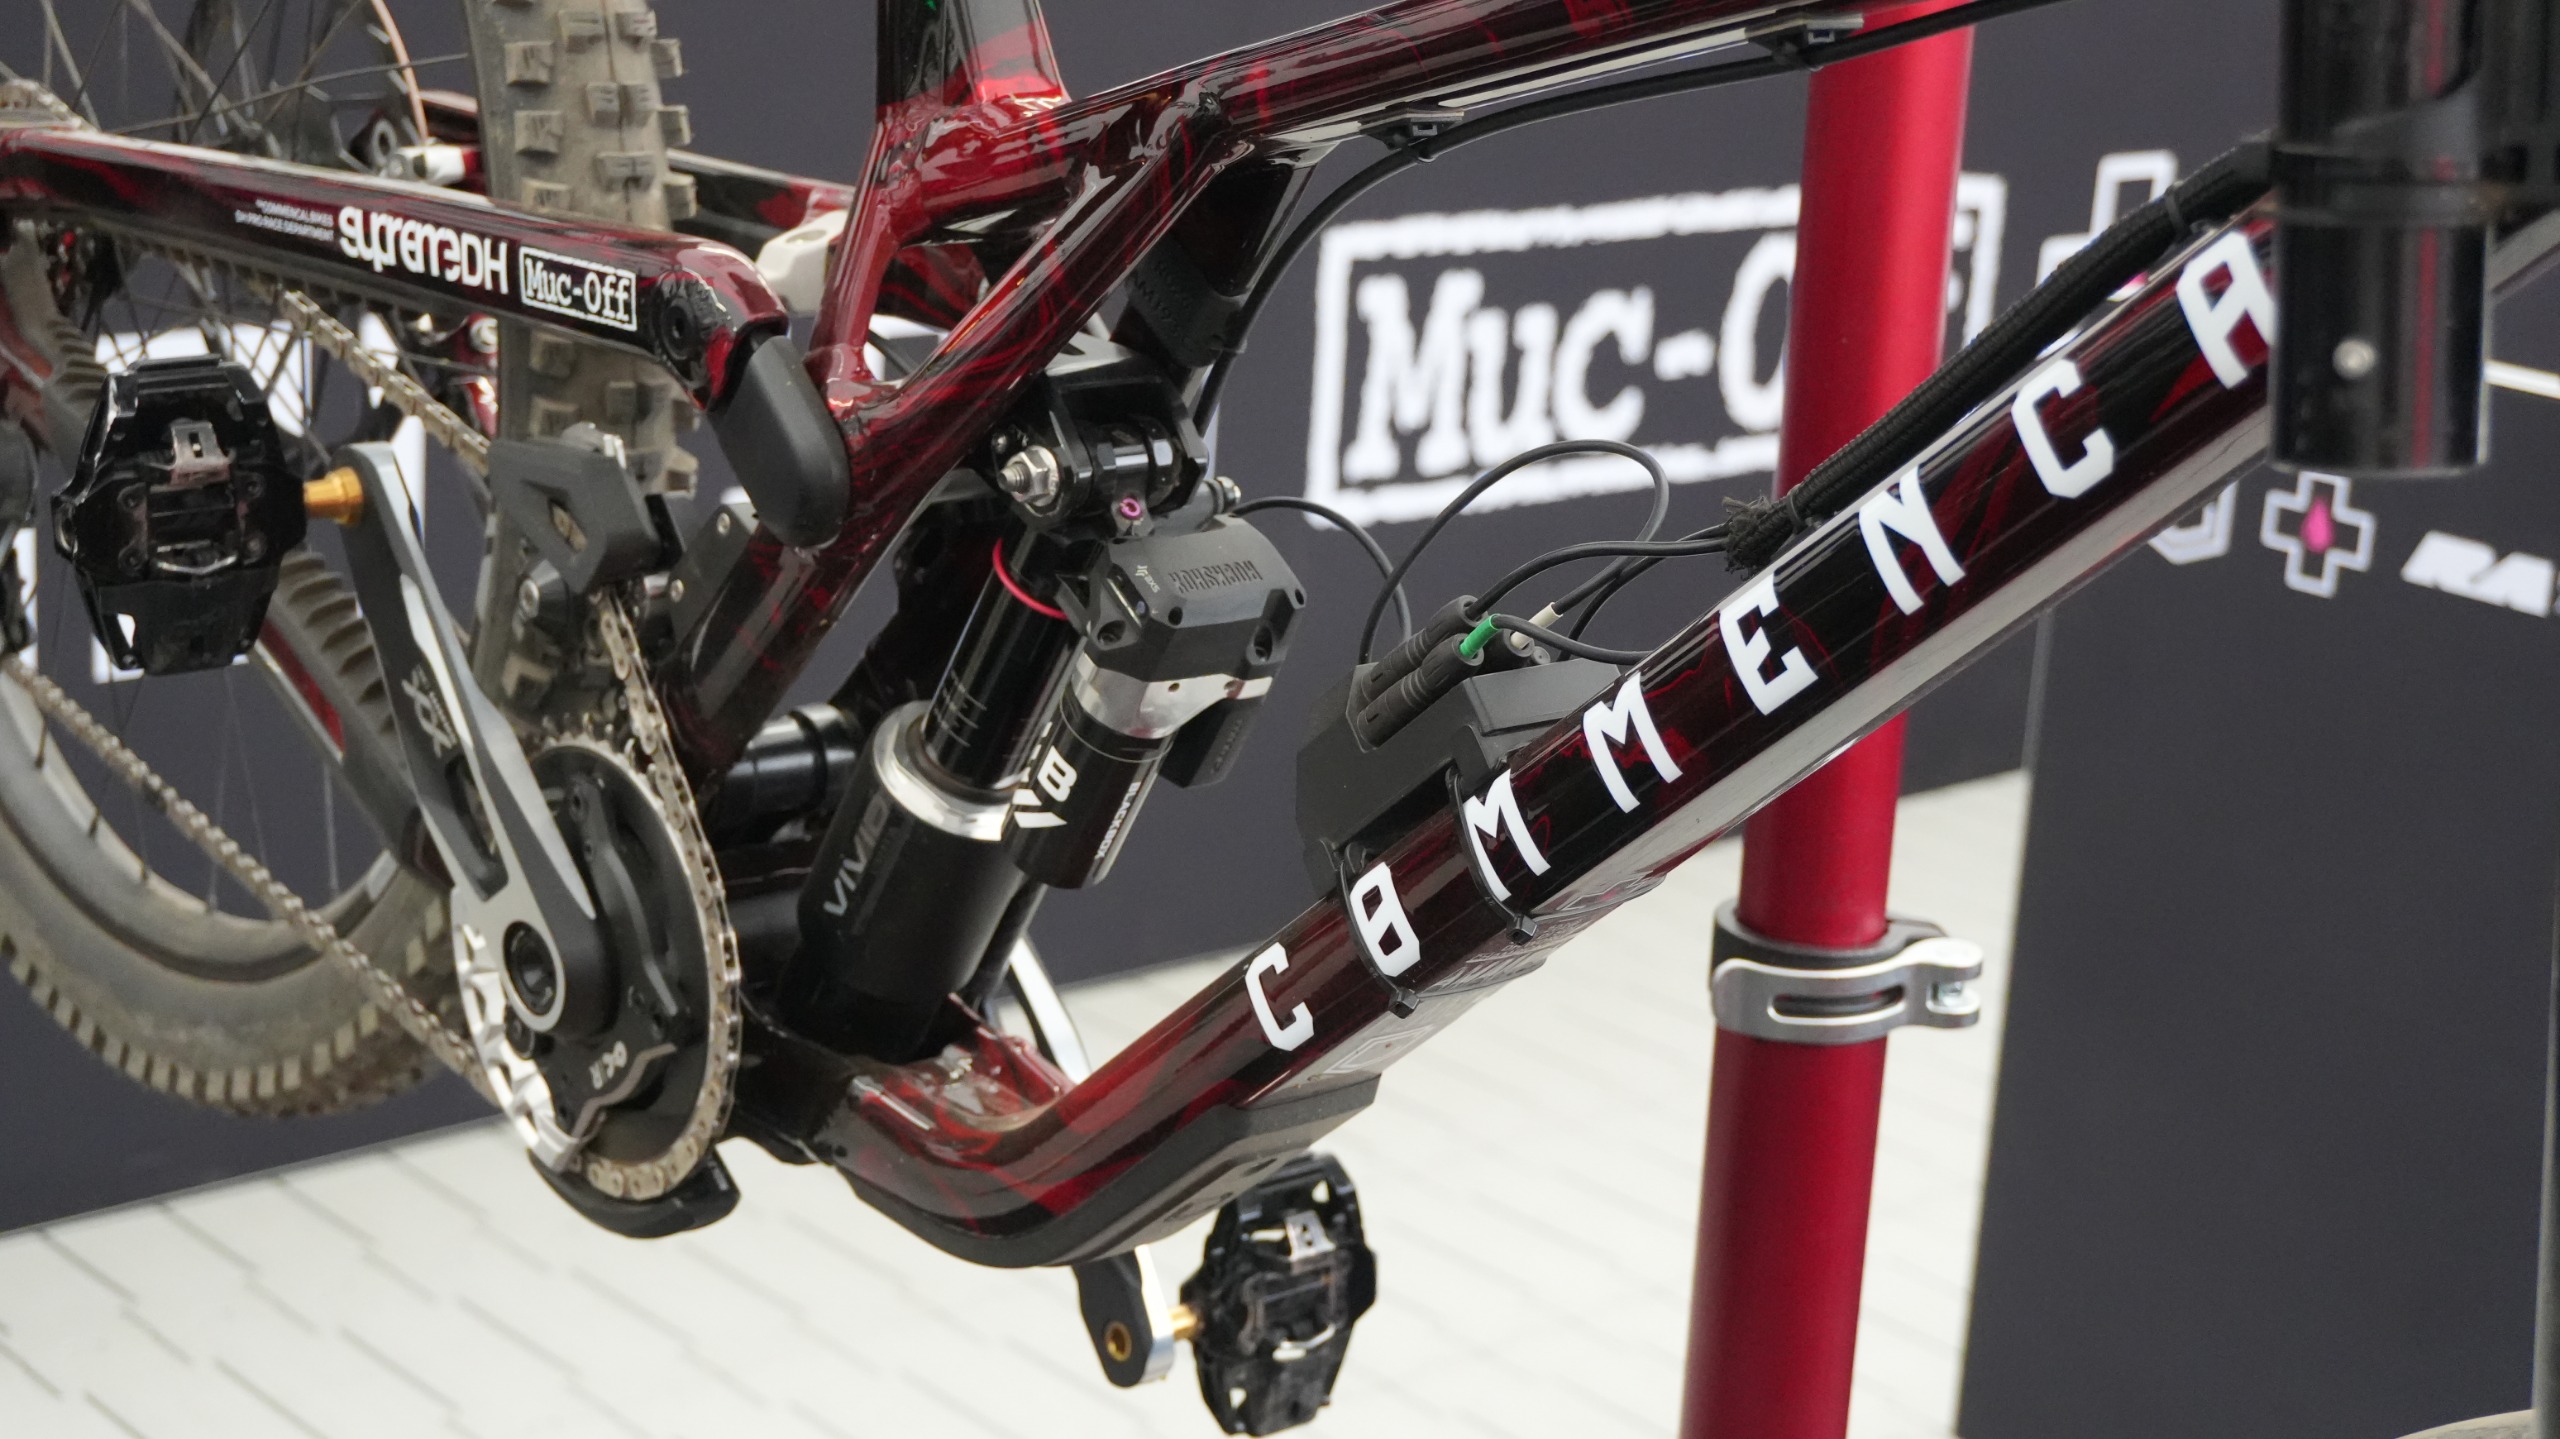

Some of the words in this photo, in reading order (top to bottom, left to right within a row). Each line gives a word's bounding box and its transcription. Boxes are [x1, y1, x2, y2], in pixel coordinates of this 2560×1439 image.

[524, 257, 631, 323] Muc-Off
[1342, 210, 1976, 484] Muc-O
[2400, 529, 2560, 618] RA
[823, 793, 890, 917] VIVID
[1094, 781, 1142, 860] BLACKBOX
